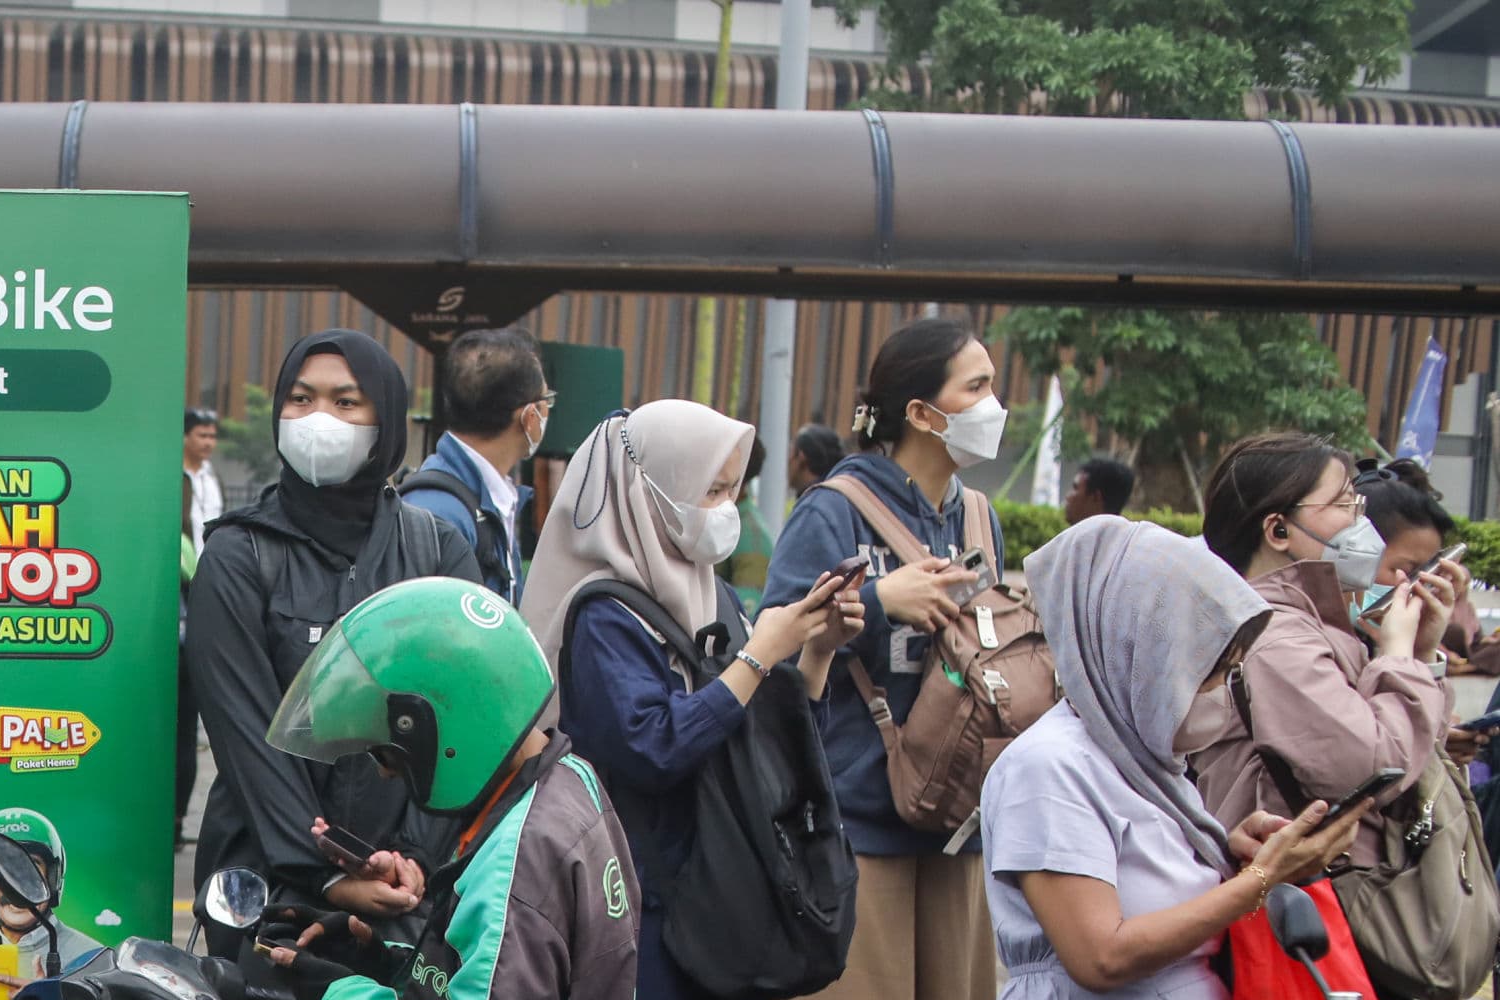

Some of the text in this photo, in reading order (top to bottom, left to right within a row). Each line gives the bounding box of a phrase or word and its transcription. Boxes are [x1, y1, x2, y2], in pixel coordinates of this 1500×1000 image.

[1, 714, 87, 750] PAHE
[16, 757, 77, 770] Paket Hemat
